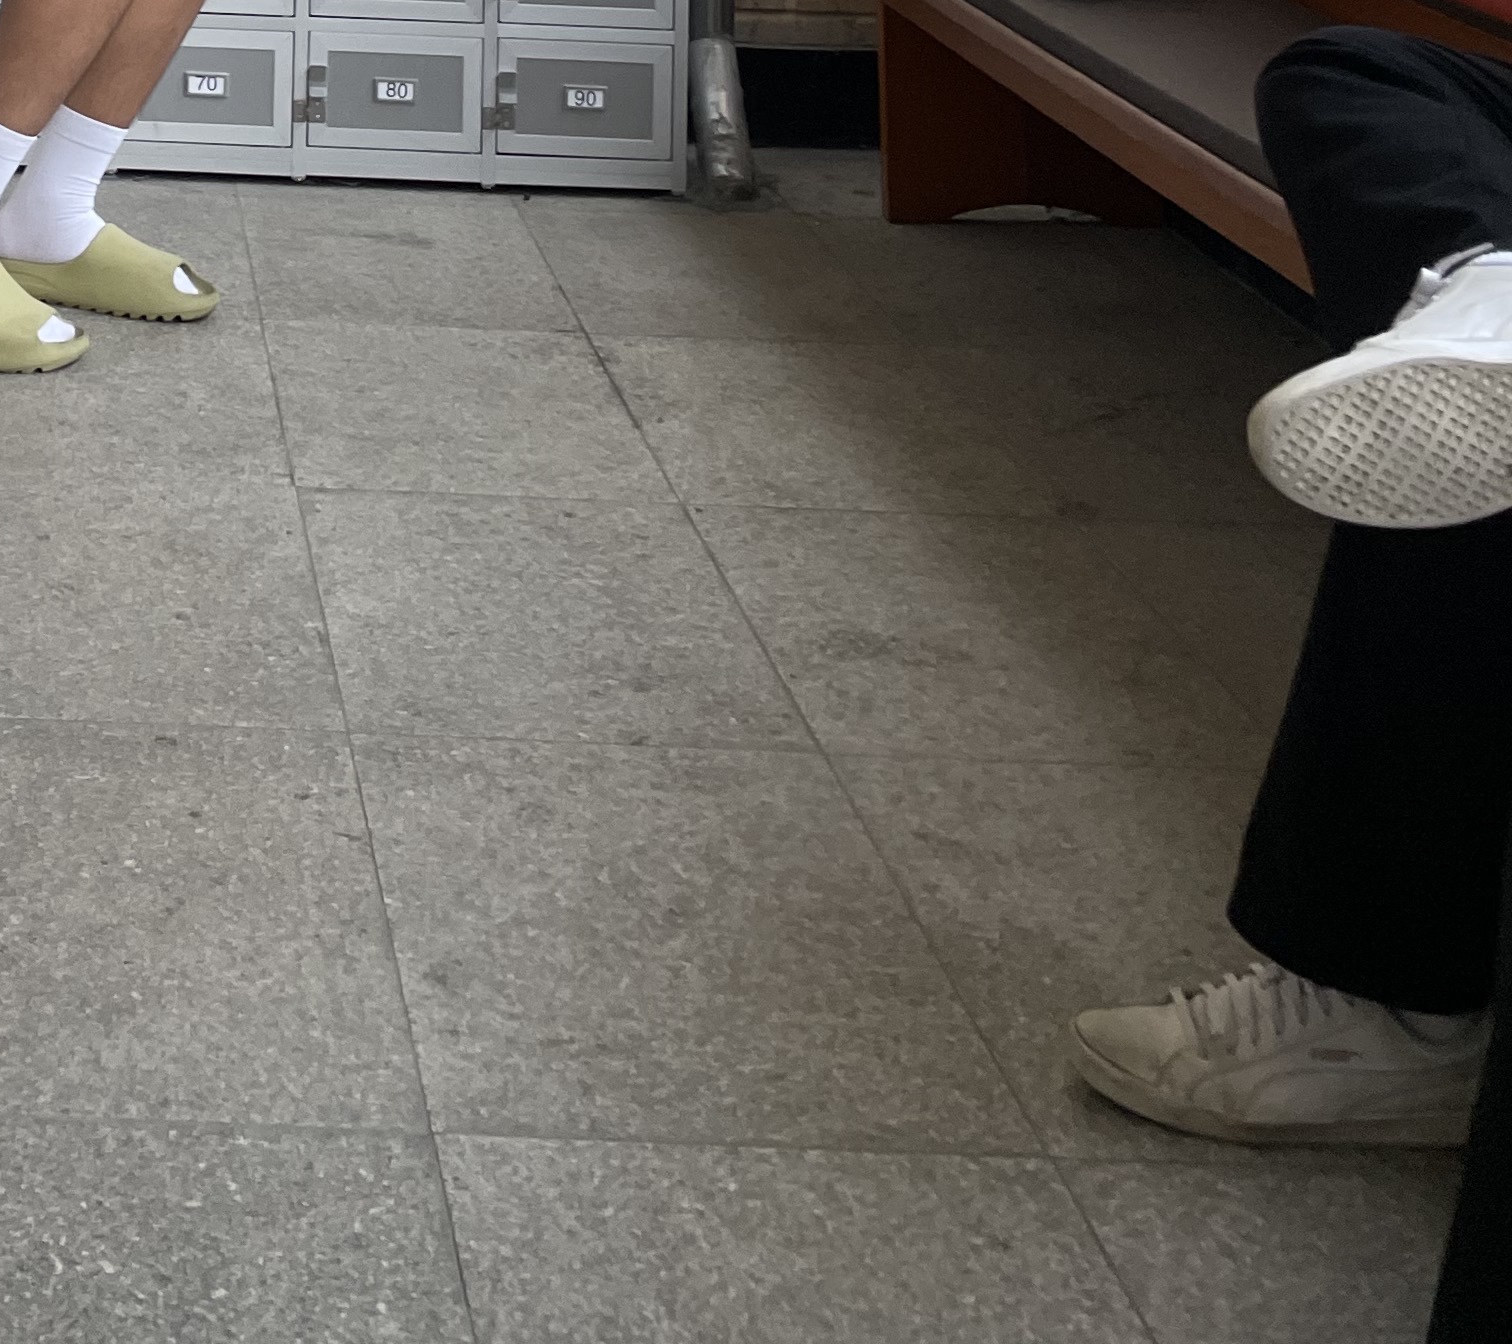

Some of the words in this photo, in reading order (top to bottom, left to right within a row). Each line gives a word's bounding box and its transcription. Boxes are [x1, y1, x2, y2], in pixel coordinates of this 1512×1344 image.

[196, 76, 217, 91] 70
[386, 83, 408, 98] 80
[574, 90, 597, 106] 90
